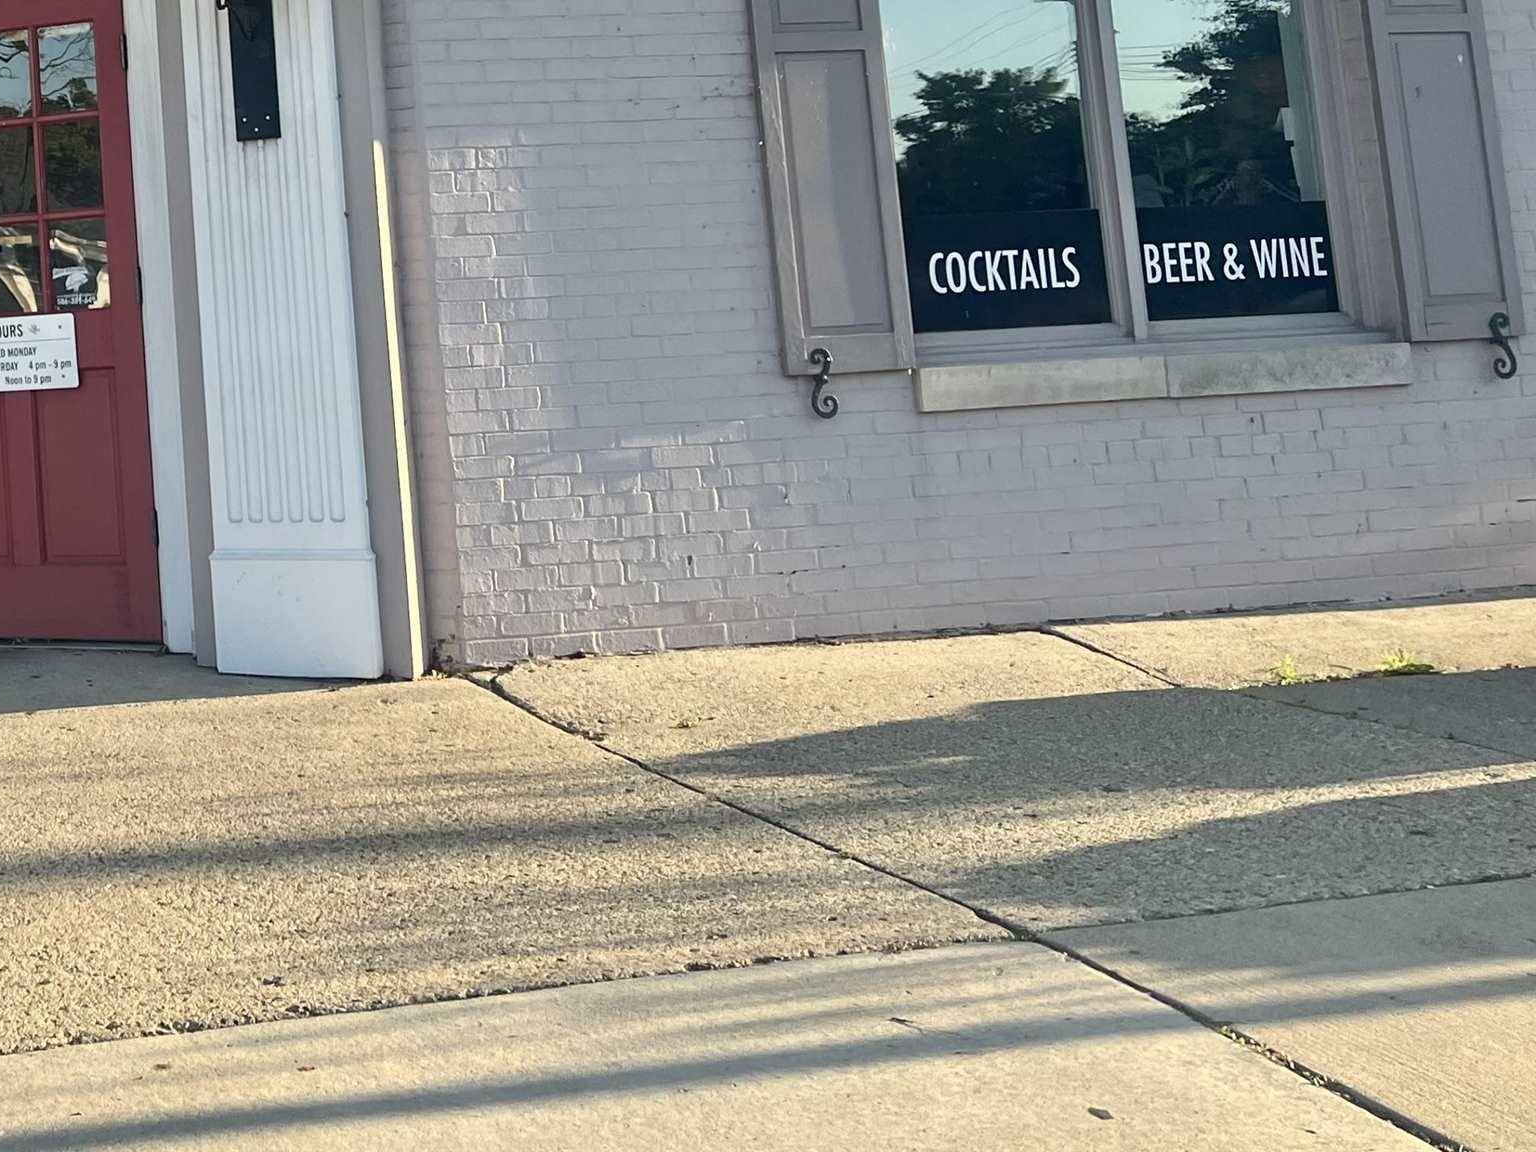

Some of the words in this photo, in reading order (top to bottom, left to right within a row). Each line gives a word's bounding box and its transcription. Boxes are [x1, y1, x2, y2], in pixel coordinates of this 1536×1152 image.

[1143, 241, 1215, 285] BEER
[1222, 242, 1246, 281] &
[1249, 236, 1329, 280] WINE
[928, 247, 1081, 295] COCKTAILS
[7, 347, 37, 358] MONDAY
[35, 361, 47, 370] pm
[60, 360, 73, 369] pm
[5, 376, 23, 385] Noon
[24, 375, 32, 385] to
[39, 375, 52, 385] pm
